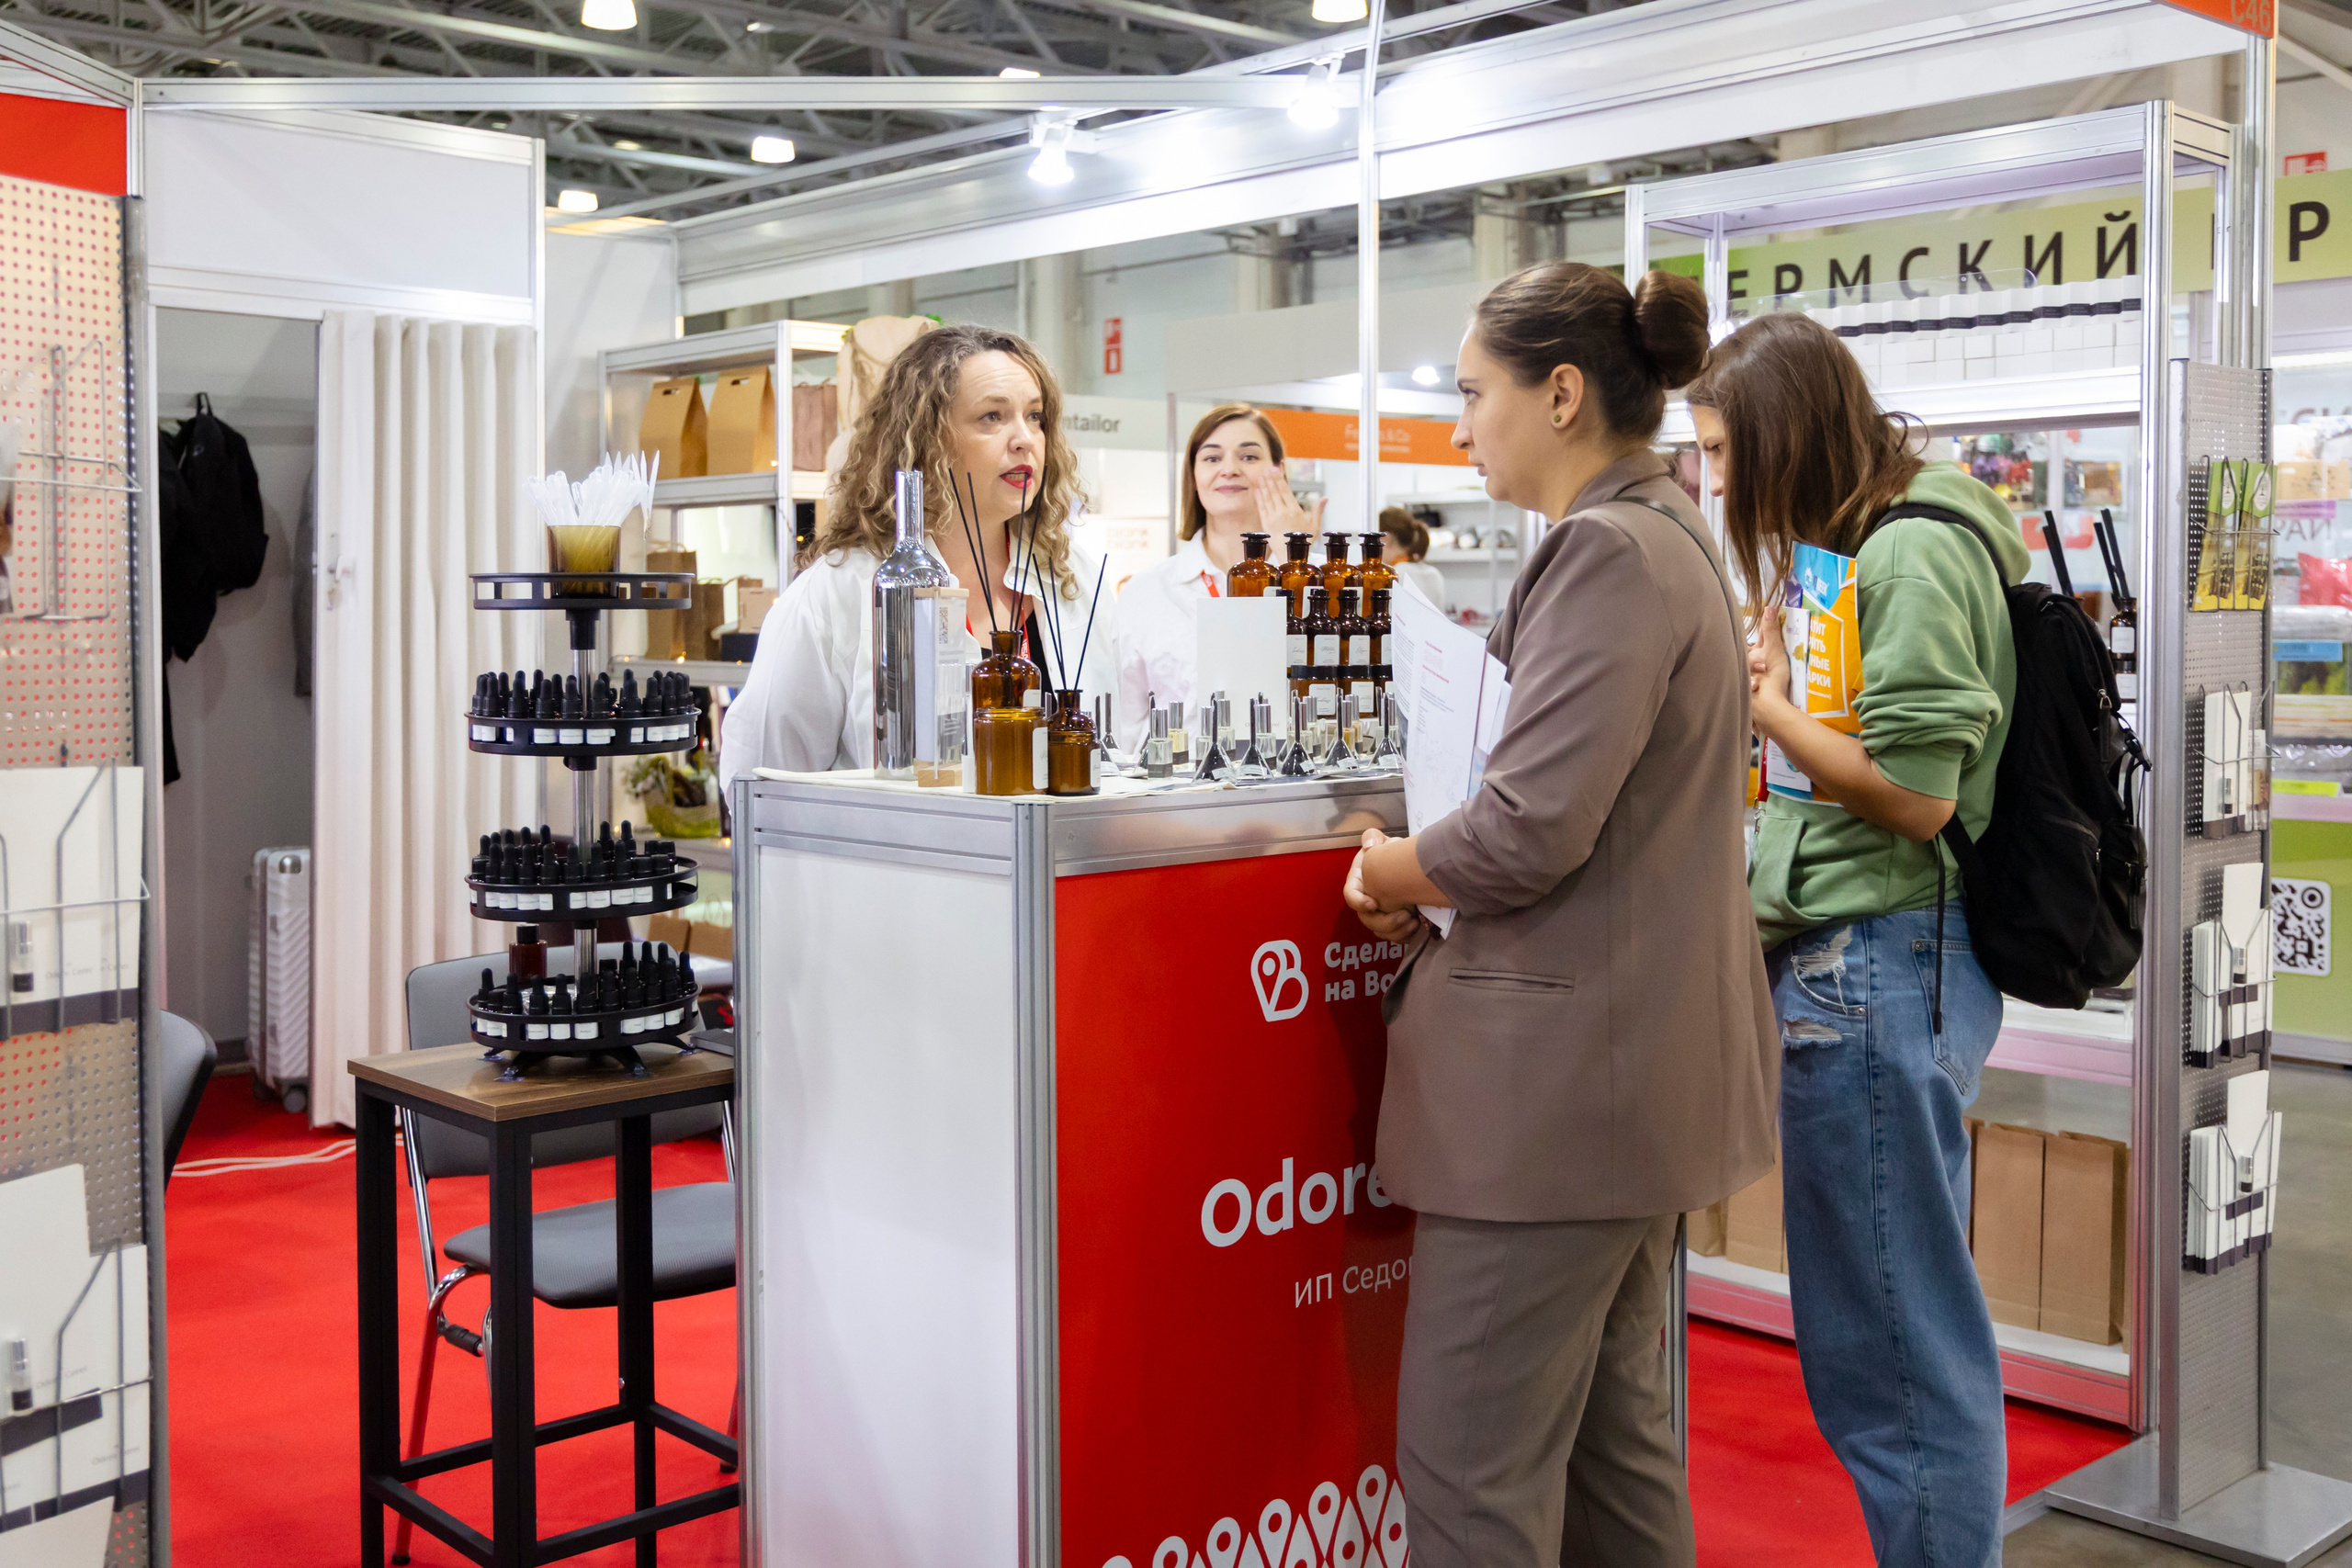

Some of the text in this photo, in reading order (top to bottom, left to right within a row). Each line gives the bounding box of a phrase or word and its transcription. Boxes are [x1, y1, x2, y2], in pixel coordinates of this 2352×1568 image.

[1687, 210, 2138, 318] ЕРМСКИЙ
[1325, 979, 1355, 1002] на
[1201, 1156, 1393, 1247] Odore
[1295, 1272, 1332, 1309] ИП
